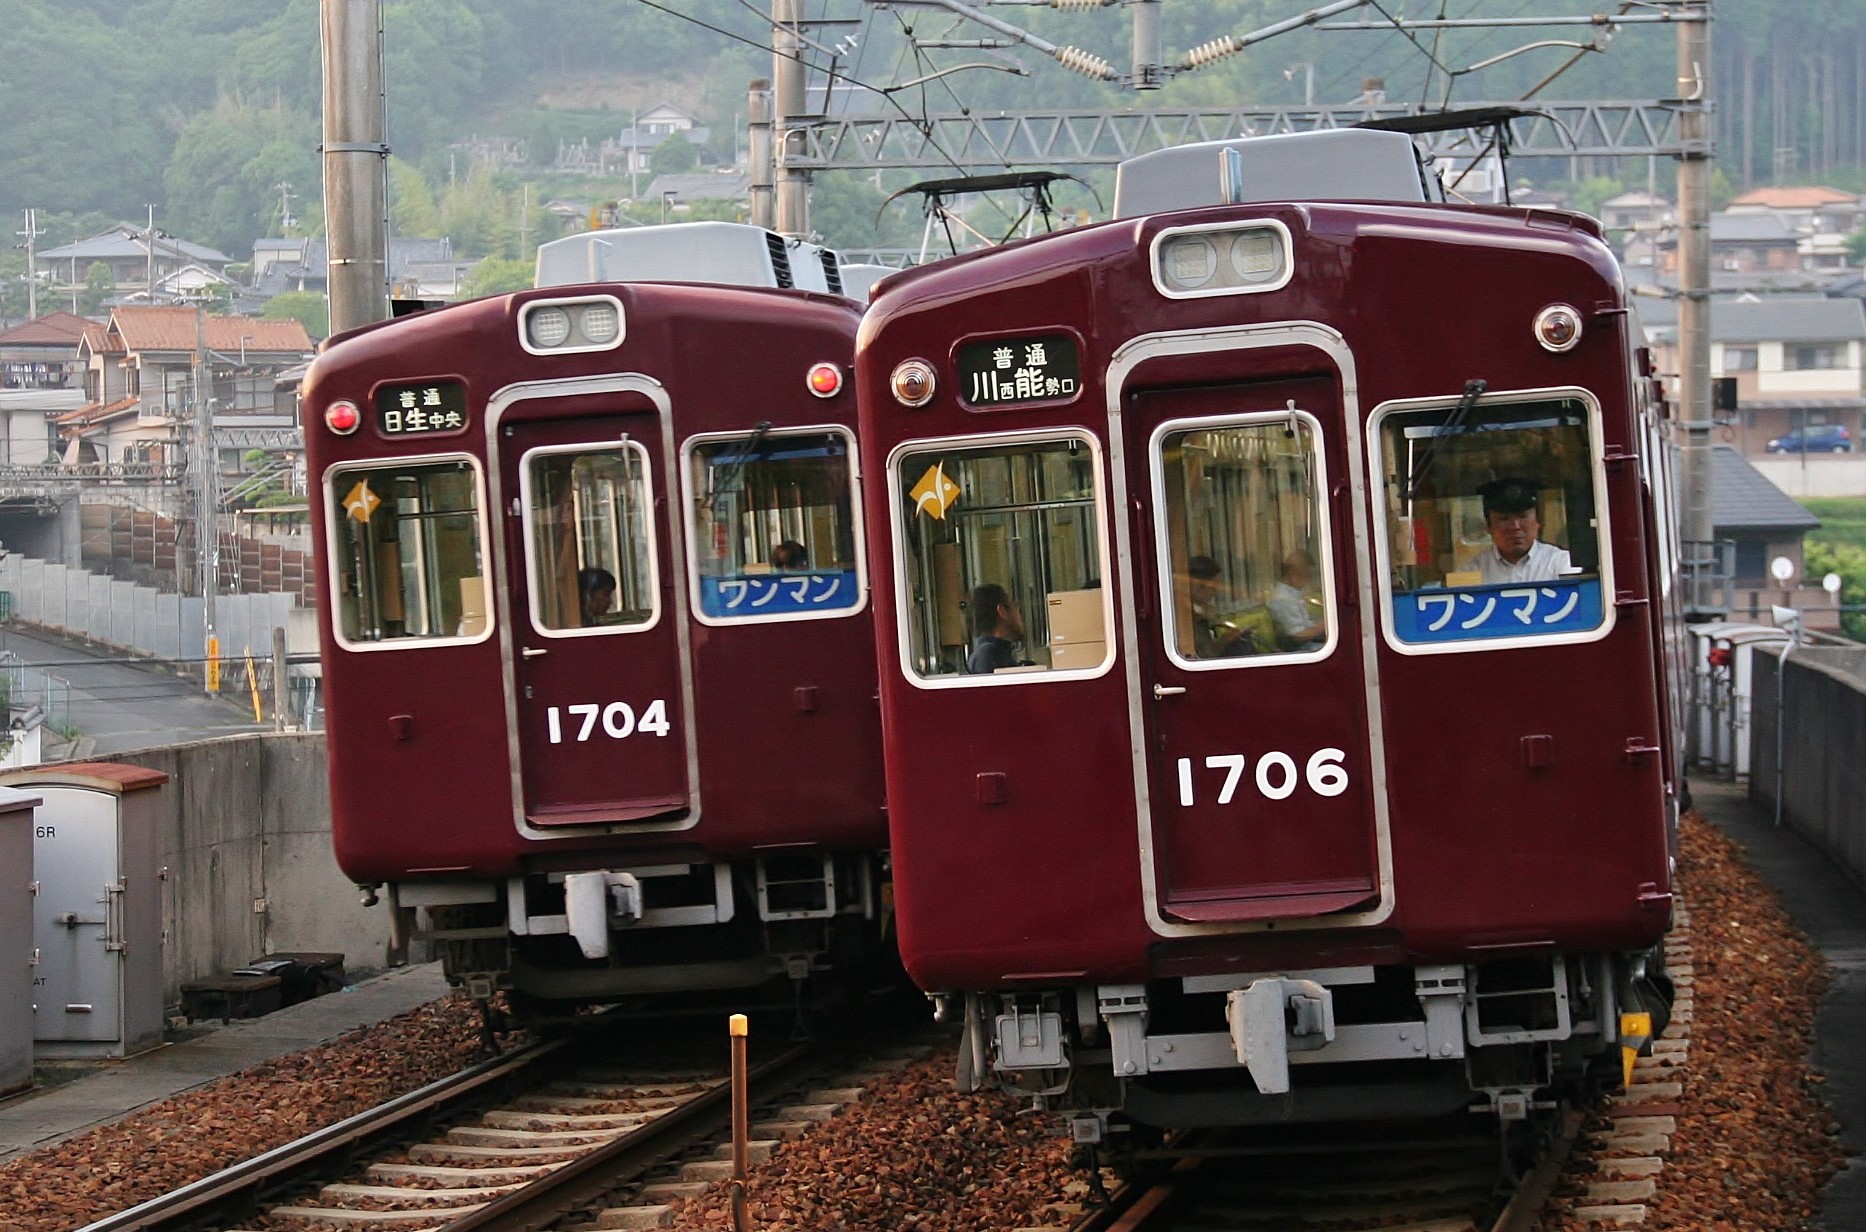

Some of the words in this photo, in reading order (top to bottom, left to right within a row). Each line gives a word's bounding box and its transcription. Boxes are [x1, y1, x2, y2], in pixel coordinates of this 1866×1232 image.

[992, 343, 1048, 369] 普通
[399, 388, 442, 408] 普通
[971, 366, 1074, 402] 川西能勢口
[385, 407, 462, 432] 日生中央
[719, 575, 840, 609] ワンマン
[1417, 587, 1579, 632] ワンマン
[547, 699, 671, 744] 1704
[1177, 747, 1349, 807] 1706
[36, 826, 56, 838] 6R
